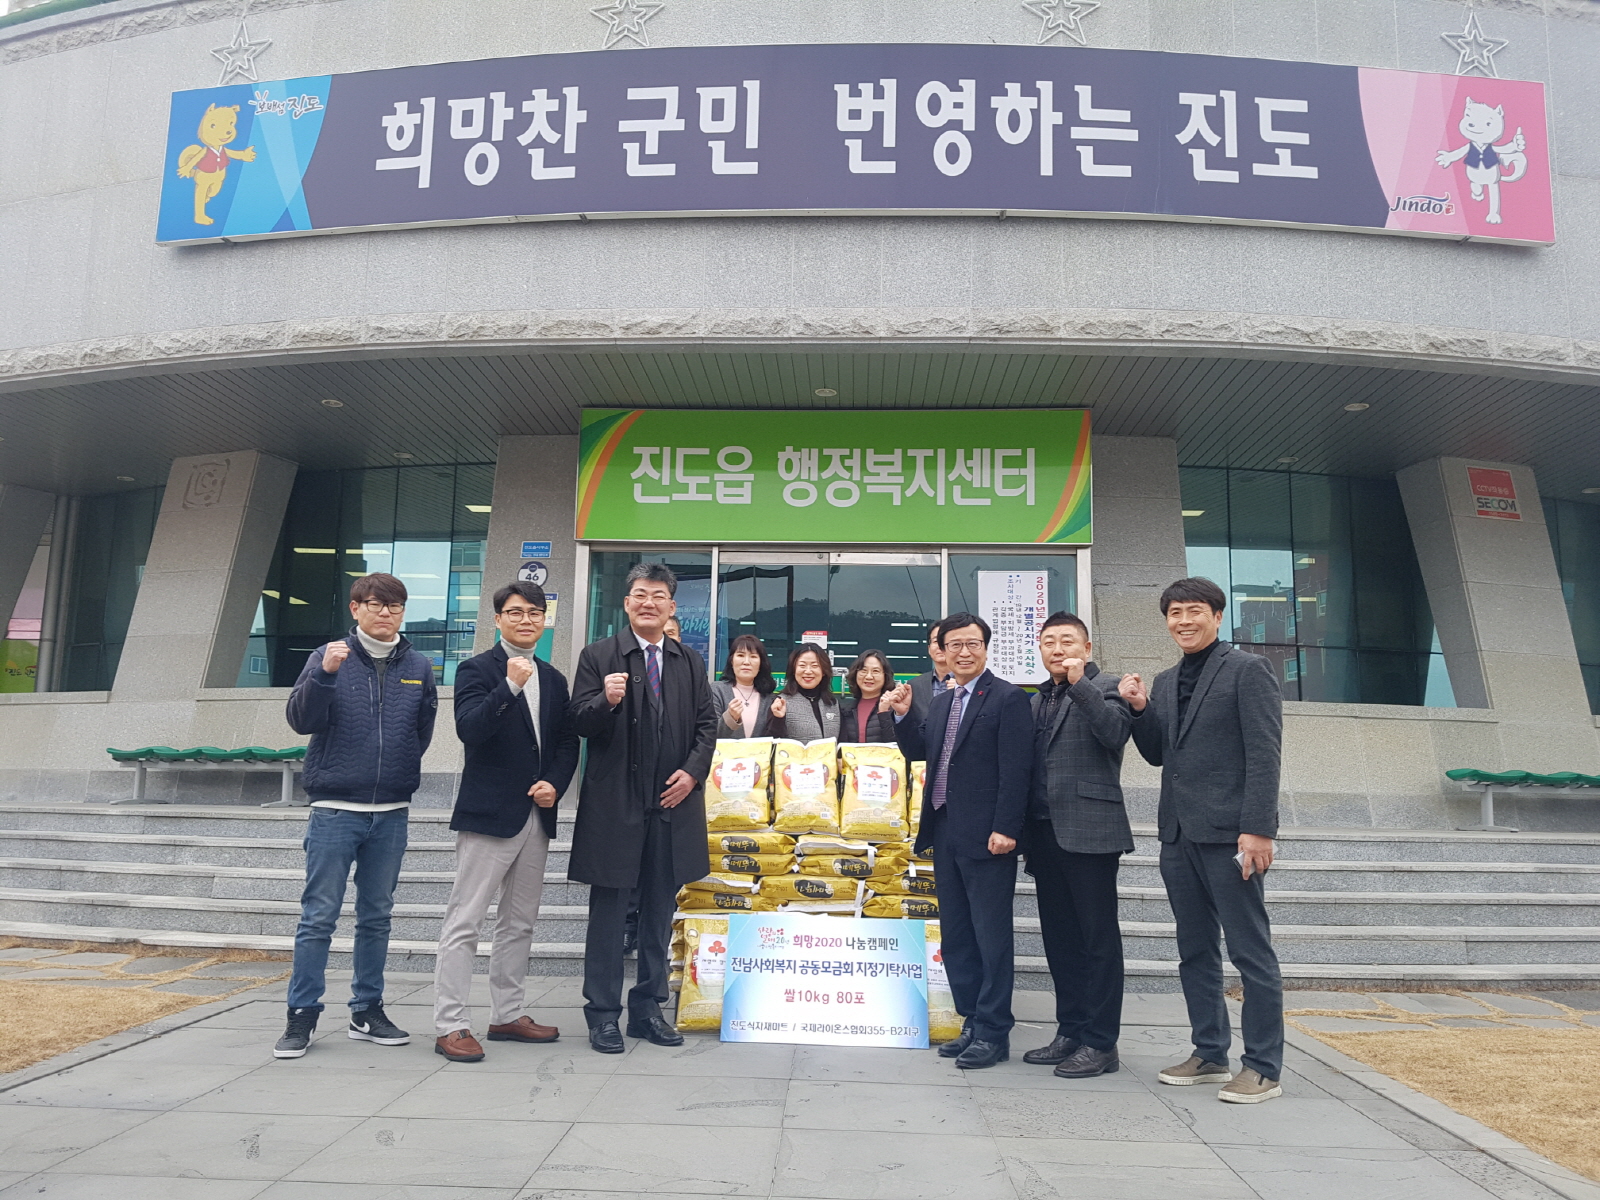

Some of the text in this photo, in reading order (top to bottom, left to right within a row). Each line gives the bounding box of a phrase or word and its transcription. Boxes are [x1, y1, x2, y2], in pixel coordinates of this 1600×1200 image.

[255, 95, 324, 119] 보배섬 진도
[376, 78, 1320, 190] 희망찬 군민 번영하는 진도
[1390, 195, 1445, 214] Jindo
[631, 445, 1036, 509] 진도읍 행정복지센터
[1477, 497, 1517, 512] SECOM
[525, 573, 540, 581] 46
[1036, 577, 1046, 619] 2020년도
[1024, 606, 1036, 675] 개별공시지가 조사착수
[992, 657, 999, 668] 토지
[1001, 664, 1007, 676] 토지
[1008, 664, 1015, 676] 토지
[730, 840, 759, 851] 메뚜기
[730, 859, 760, 870] 메뚜기
[792, 934, 843, 948] 희망2020
[845, 937, 899, 951] 나눔캠페인
[730, 957, 797, 974] 전남사회복지
[798, 960, 854, 977] 공동모금회
[856, 961, 922, 979] 지정기탁사업
[784, 988, 866, 1005] 쌀10kg 80포
[730, 1020, 789, 1033] 진도식자재마트
